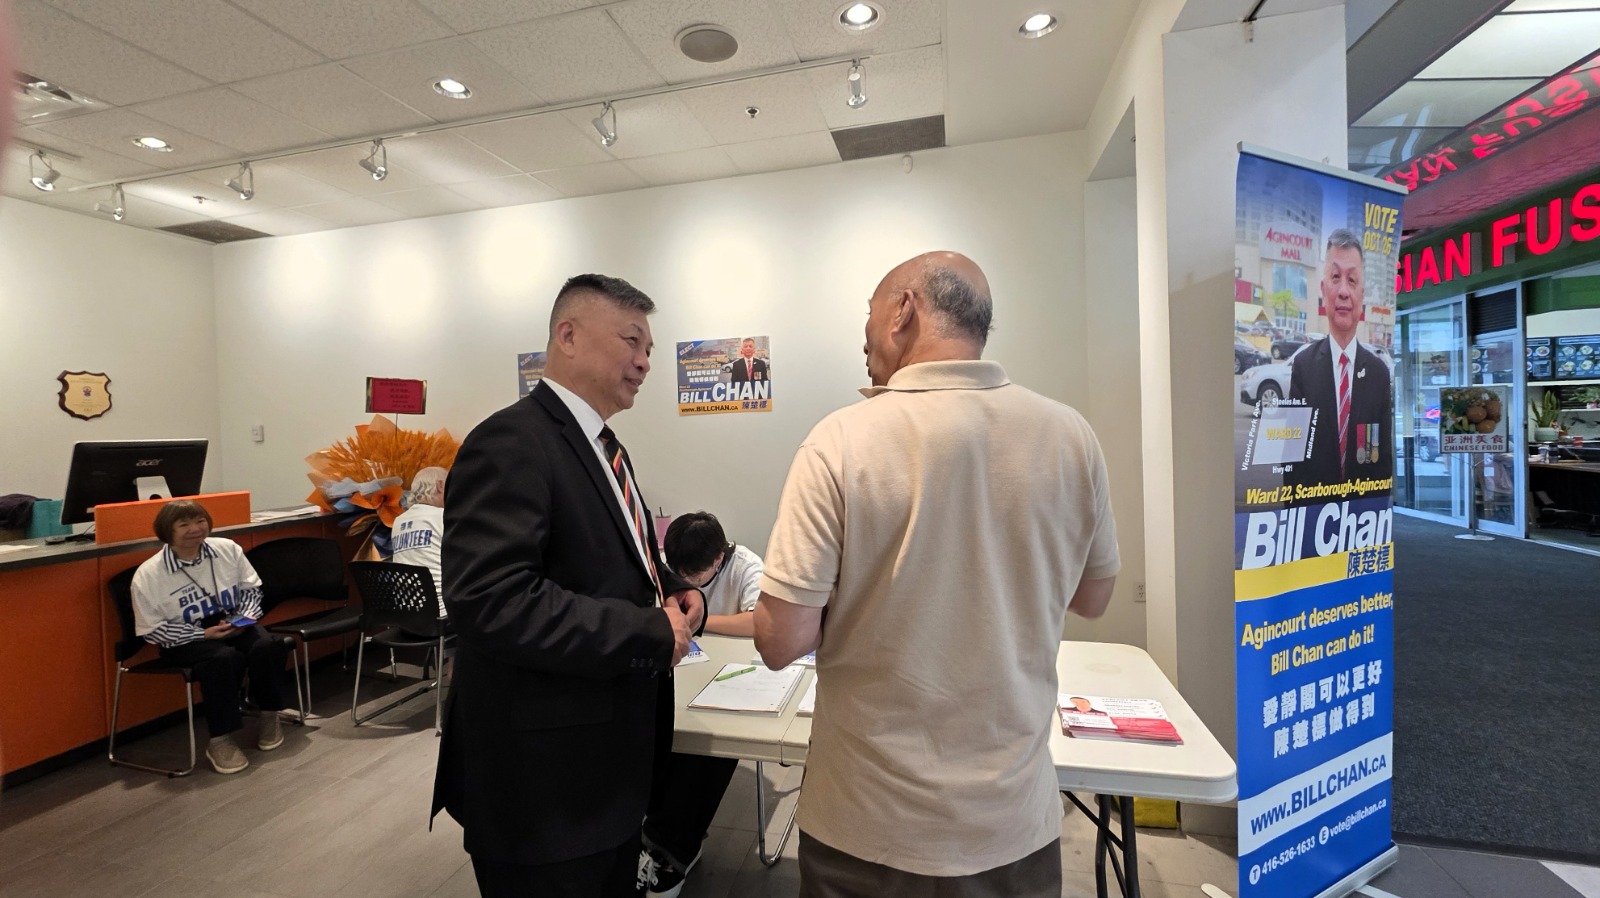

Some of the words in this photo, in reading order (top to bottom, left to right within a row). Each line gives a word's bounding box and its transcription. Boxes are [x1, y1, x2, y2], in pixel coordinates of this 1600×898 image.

[1365, 202, 1399, 233] VOTE
[1492, 183, 1600, 267] FUS
[1363, 231, 1381, 252] OCT
[1382, 236, 1393, 255] 26
[680, 391, 711, 404] BILL
[712, 380, 769, 402] CHAN
[1253, 400, 1261, 417] Ave.
[1249, 418, 1258, 438] Park
[1267, 428, 1291, 440] WARD
[1294, 427, 1302, 439] 22
[1444, 434, 1504, 444] 亚洲美食
[1241, 439, 1254, 471] Victoria
[1306, 427, 1316, 459] Midland
[136, 459, 163, 467] acer
[1272, 466, 1284, 474] Hwy
[1246, 488, 1279, 504] Ward
[1280, 485, 1293, 503] 22,
[1295, 476, 1393, 499] Scarborough-Agincourt
[1242, 507, 1307, 570] Bill
[1315, 501, 1393, 557] Chan
[1346, 545, 1391, 578] 陳楚標
[182, 585, 196, 594] TEAM
[1241, 610, 1306, 650] Agincourt
[1309, 601, 1358, 629] deserves
[1361, 592, 1393, 614] better,
[1271, 649, 1289, 676] Bill
[1292, 643, 1323, 667] Chan
[1326, 637, 1346, 657] can
[1349, 630, 1361, 650] do
[1363, 624, 1375, 645] it!
[1262, 835, 1316, 875] 416-526-1633
[1330, 798, 1387, 837] vote@billchan.ca
